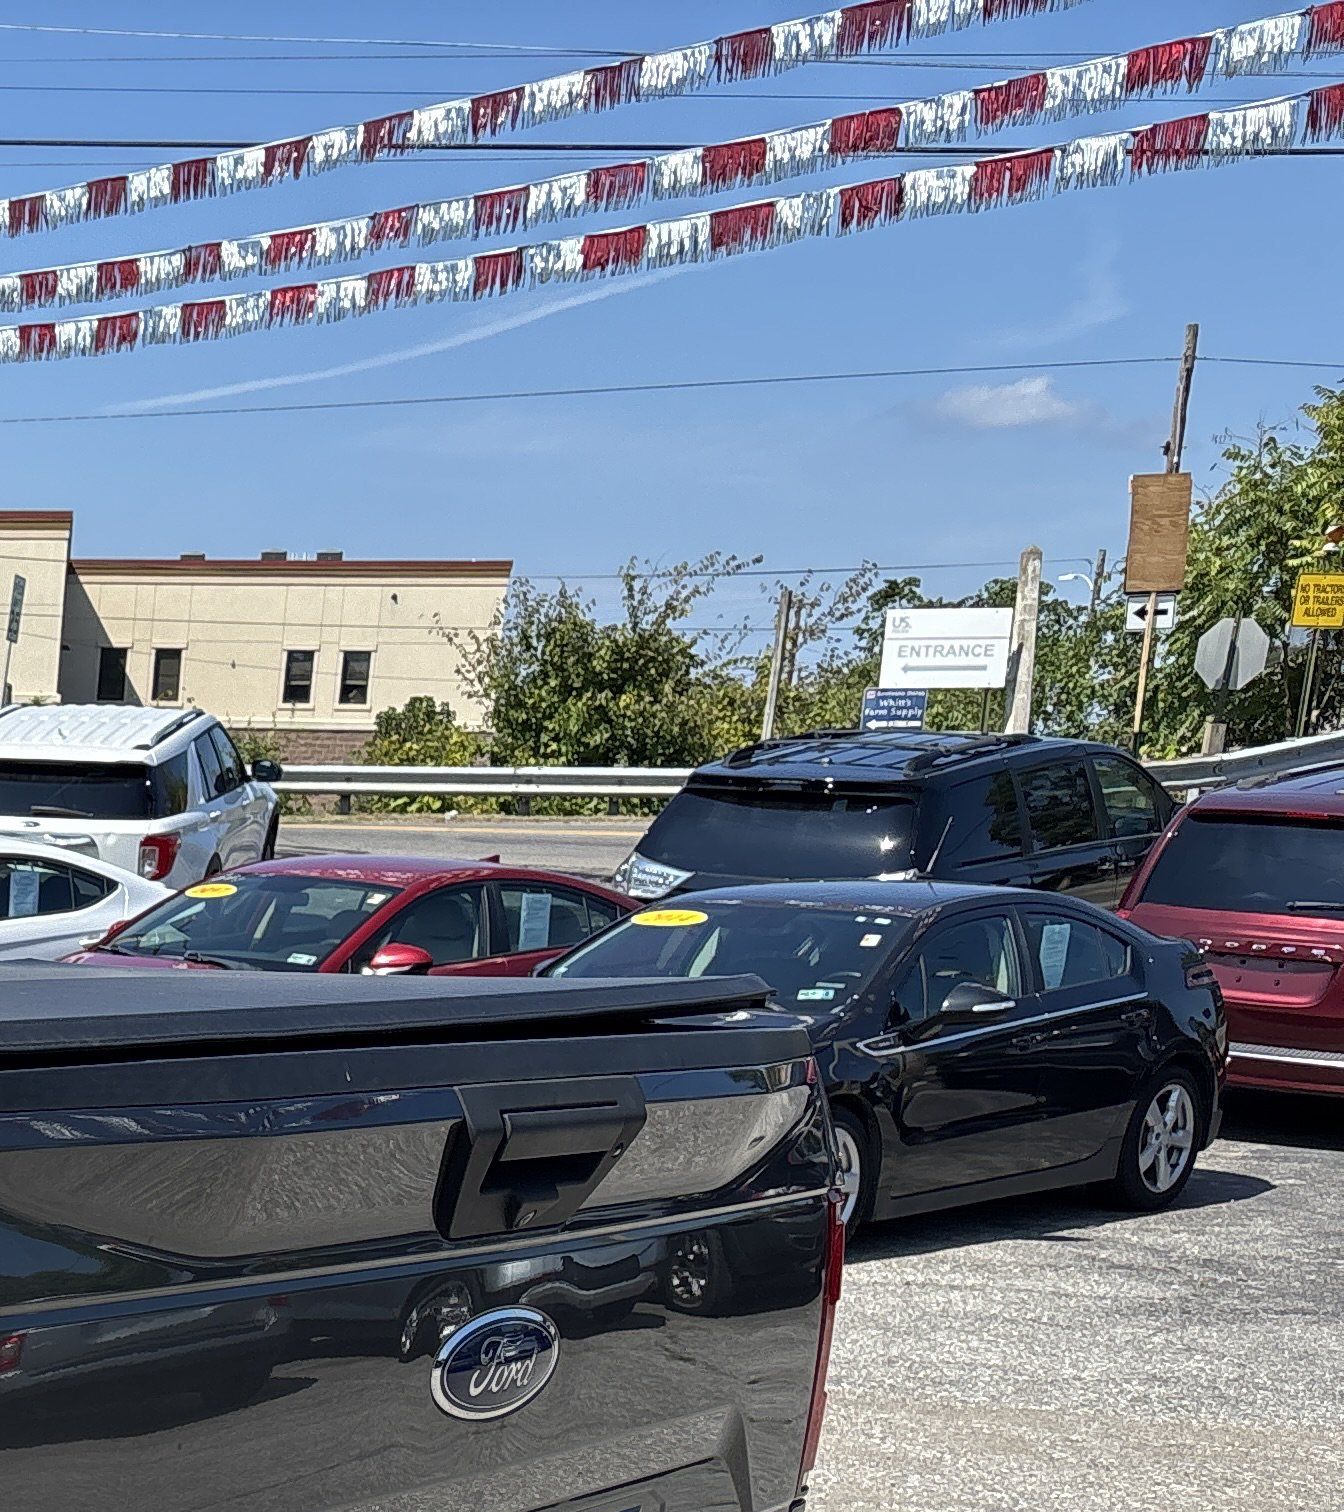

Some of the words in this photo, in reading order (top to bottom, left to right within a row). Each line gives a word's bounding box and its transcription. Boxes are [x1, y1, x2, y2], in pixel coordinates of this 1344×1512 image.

[1300, 583, 1311, 594] NO
[1299, 595, 1311, 605] OR
[1302, 607, 1337, 617] ALLOWED
[897, 644, 995, 658] ENTRANCE
[890, 706, 923, 718] Supply
[469, 1335, 541, 1397] Ford
